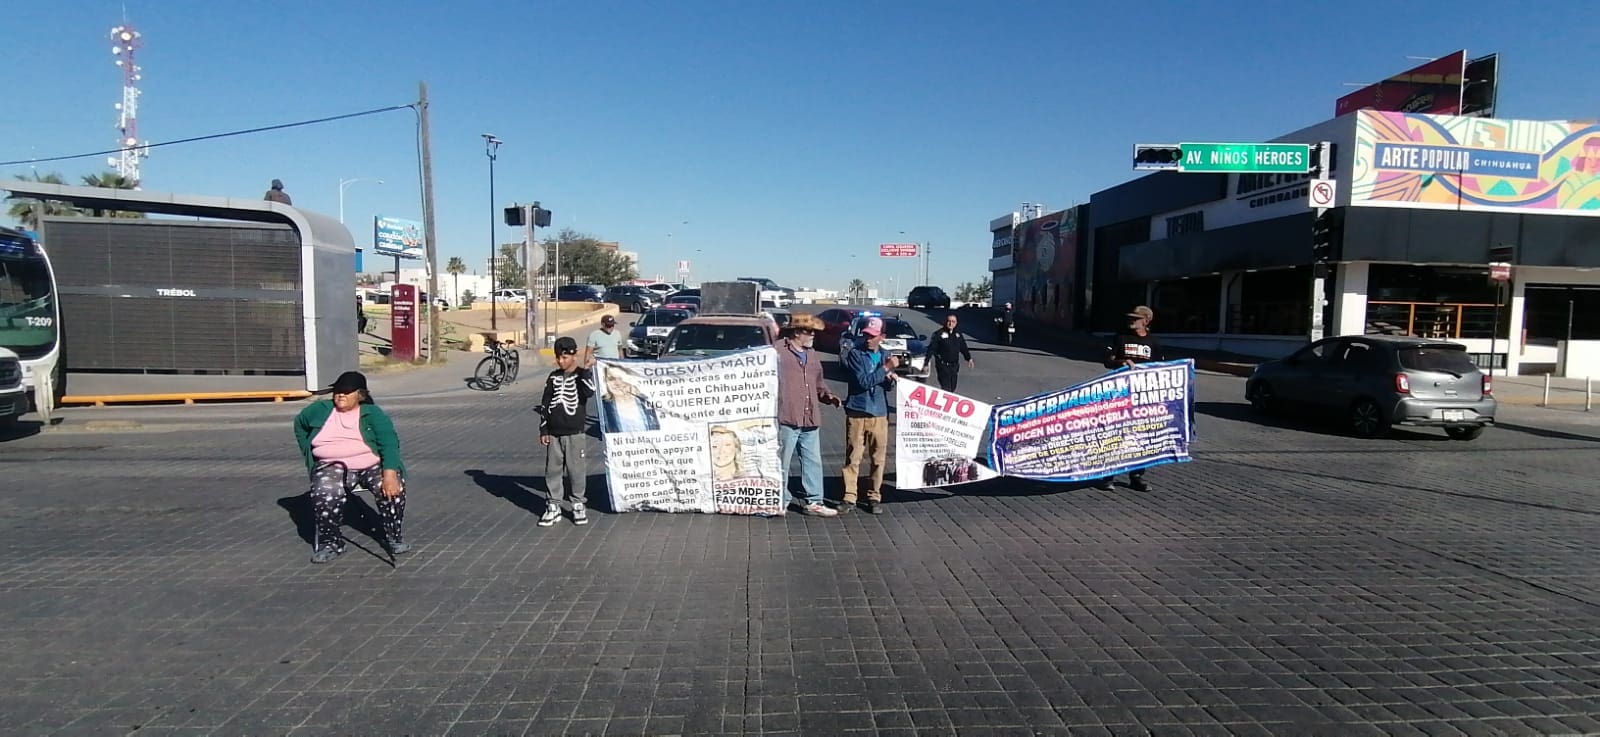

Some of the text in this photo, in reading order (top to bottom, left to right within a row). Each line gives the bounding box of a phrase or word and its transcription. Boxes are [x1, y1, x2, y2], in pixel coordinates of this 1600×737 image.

[1186, 147, 1302, 165] AV. NIÑOS HÉROES
[1381, 147, 1532, 171] ARTE POPULAR CHIHUAHUA
[1250, 187, 1309, 208] CHIHUAHU
[156, 288, 196, 297] TRÉBOL
[25, 316, 52, 327] T-209
[643, 355, 767, 377] COESVI Y MARU
[688, 375, 720, 383] casas
[740, 369, 777, 379] Juárez
[1129, 369, 1184, 393] MARU
[705, 381, 765, 393] Chihuahua
[646, 391, 770, 409] NO QUIEREN APOYAR
[909, 385, 976, 418] ALTO
[1131, 388, 1184, 406] CAMPOS
[718, 408, 732, 416] de
[736, 403, 760, 415] aquí
[1013, 426, 1045, 443] DICEN
[1046, 423, 1063, 436] NO
[1065, 410, 1131, 430] CONOCERLA
[638, 436, 662, 444] Maru
[664, 432, 698, 442] COESVI
[1048, 436, 1084, 448] DIRECTOR
[664, 446, 694, 456] apoyar
[676, 458, 694, 466] que
[624, 478, 698, 490] puros corptos
[623, 492, 649, 501] como
[738, 488, 762, 496] MDP
[765, 488, 780, 497] EN
[716, 496, 780, 506] FAVORECER
